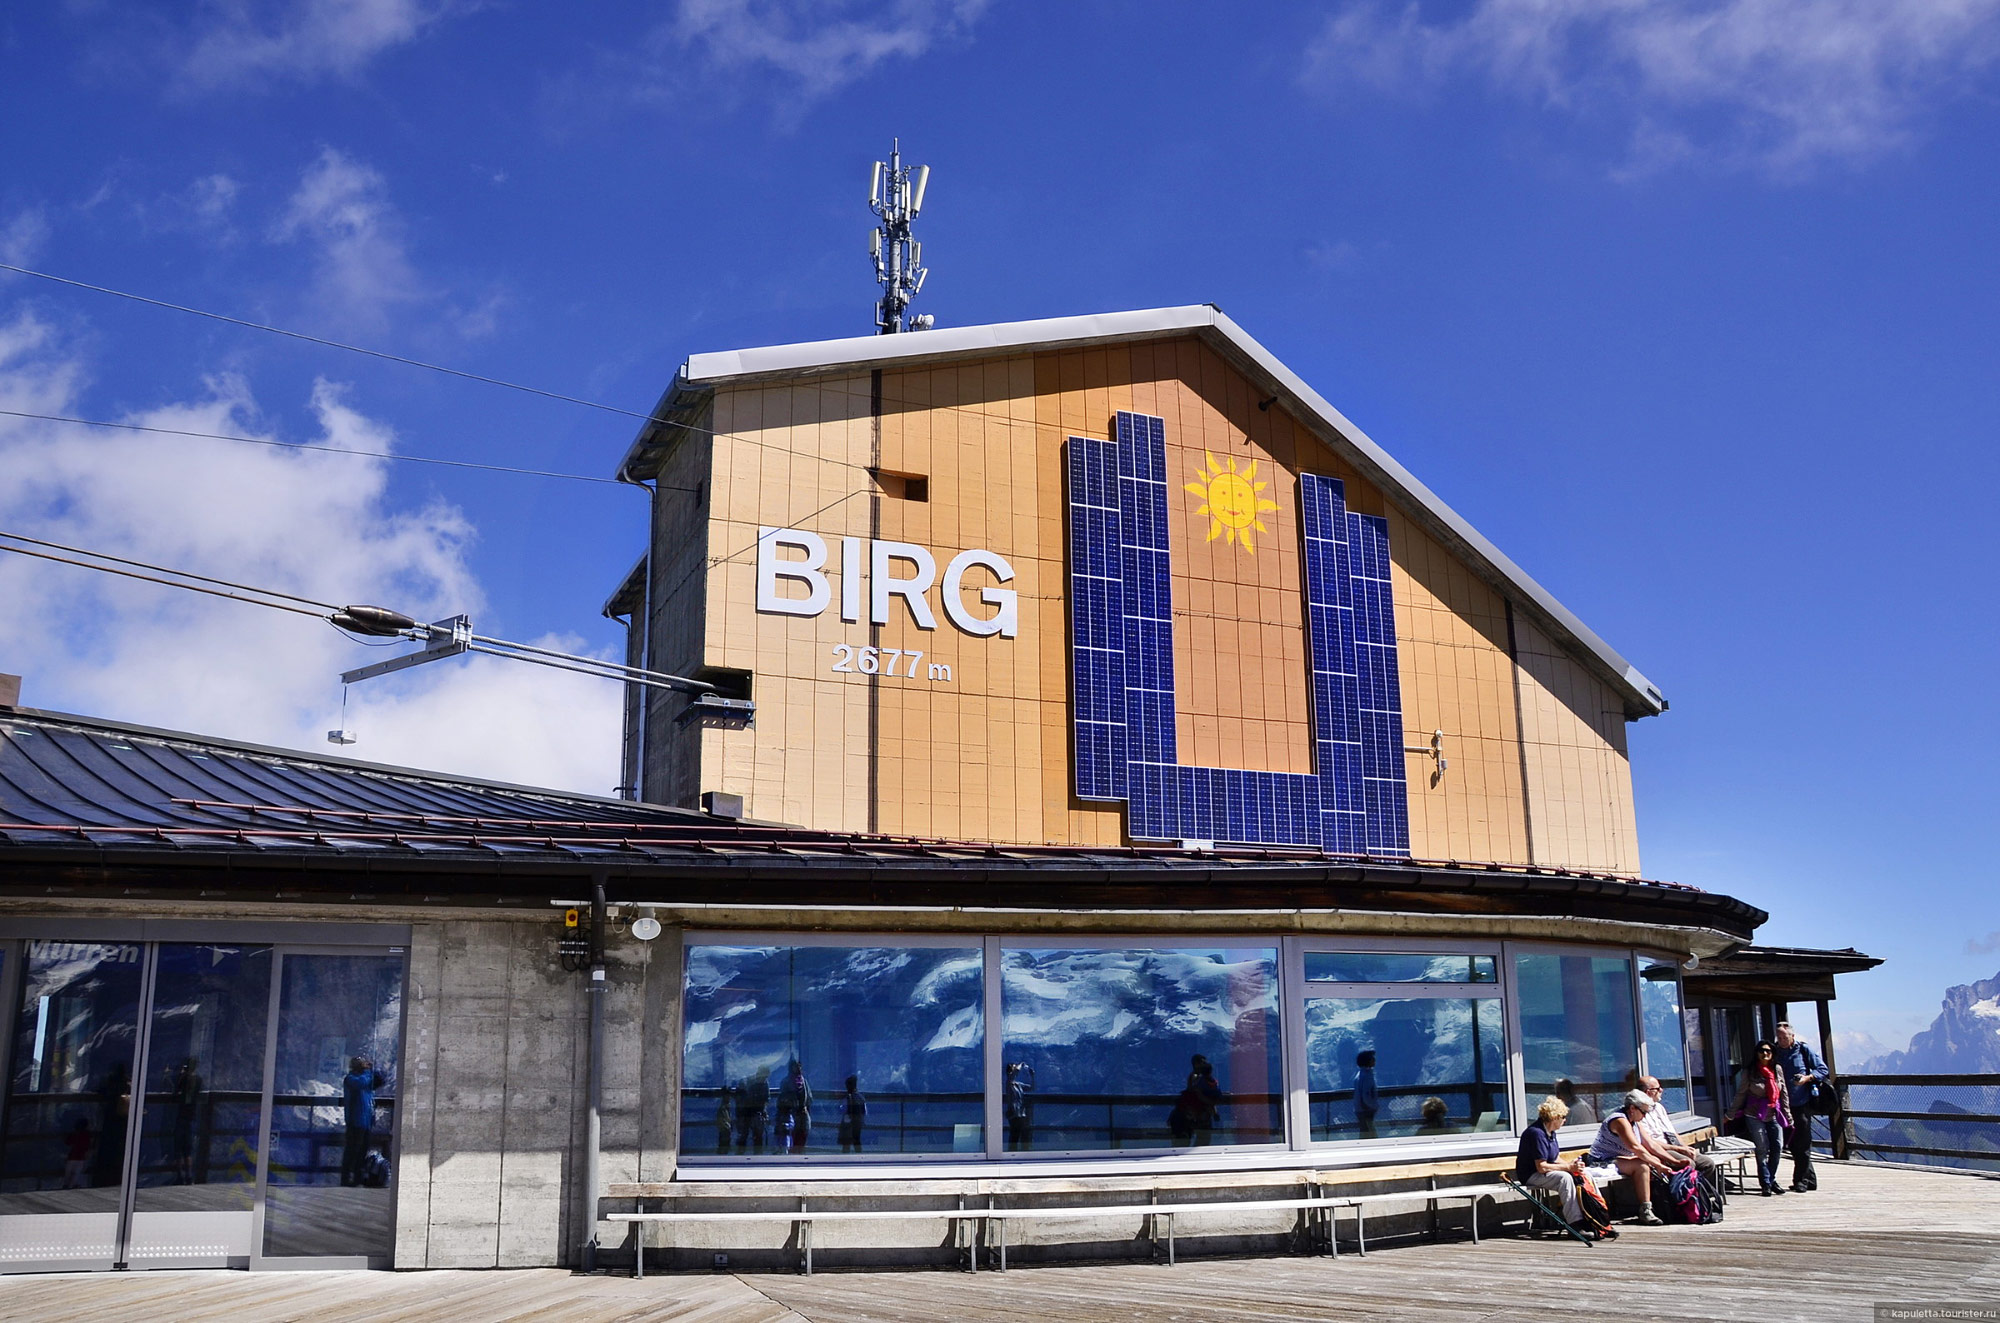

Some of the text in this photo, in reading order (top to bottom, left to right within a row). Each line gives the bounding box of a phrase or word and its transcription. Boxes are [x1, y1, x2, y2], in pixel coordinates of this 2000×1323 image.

[757, 525, 1018, 637] BIRG
[832, 643, 952, 681] 2677 m
[23, 939, 139, 963] Mürren
